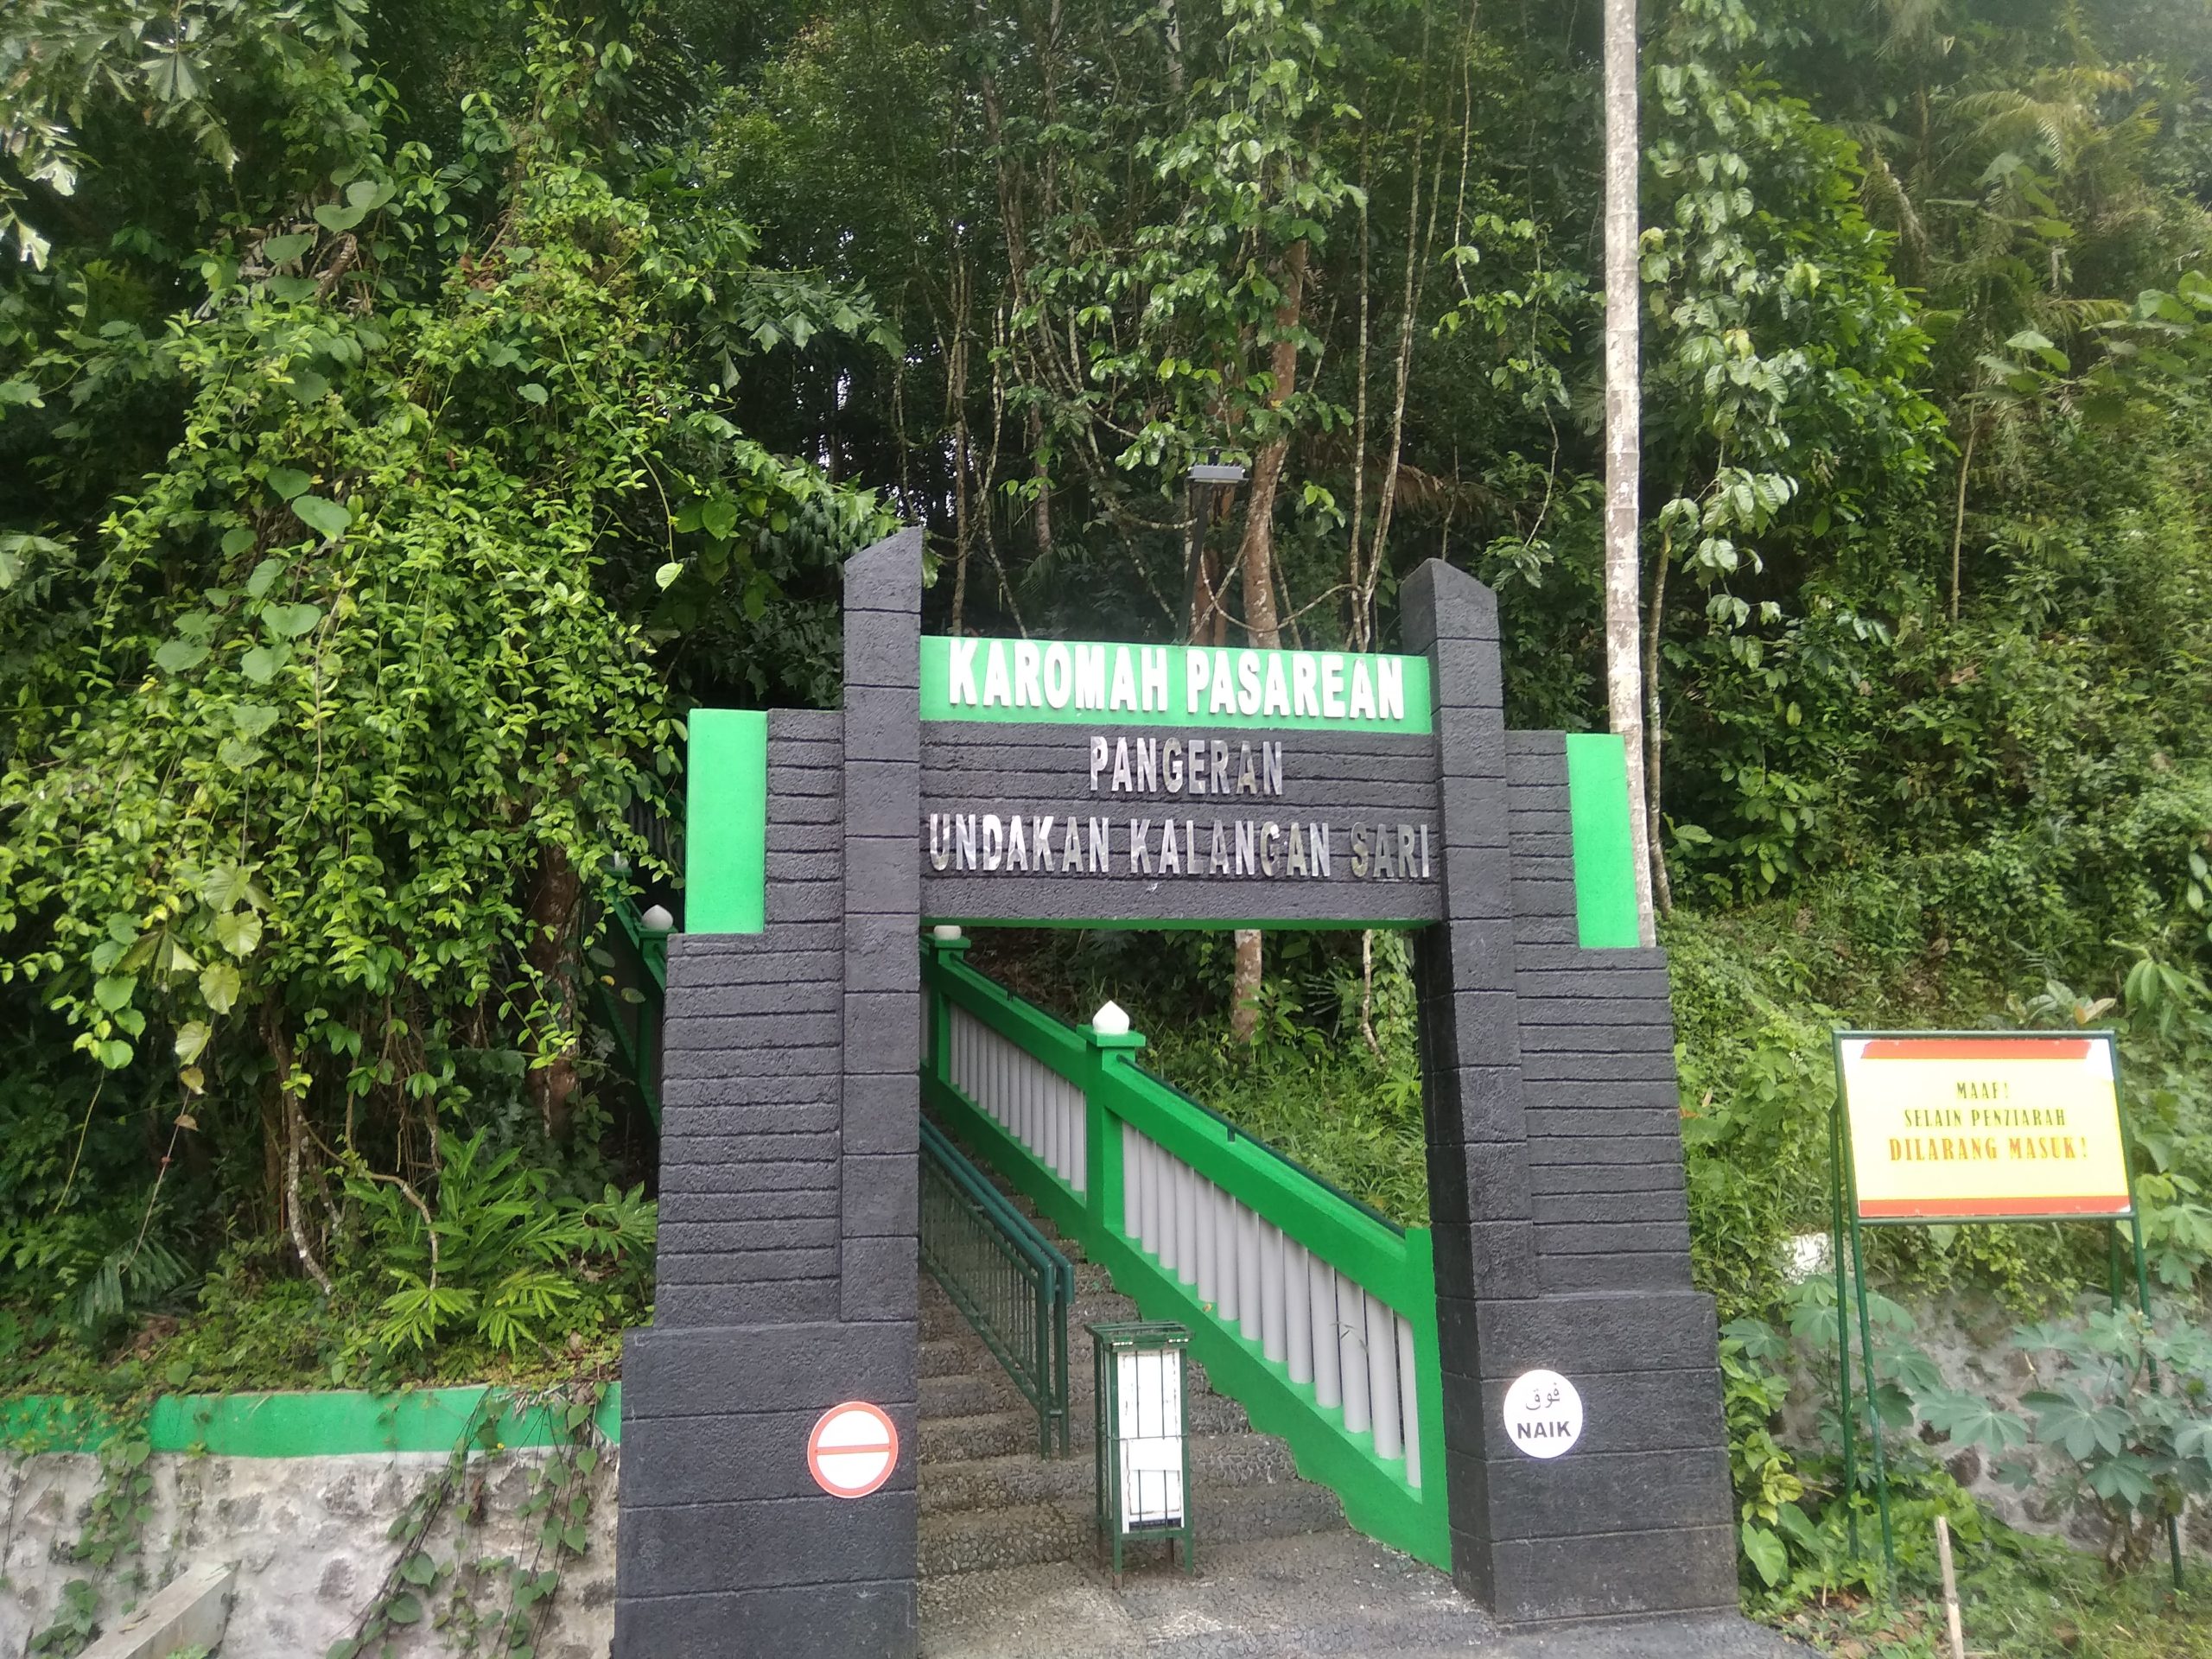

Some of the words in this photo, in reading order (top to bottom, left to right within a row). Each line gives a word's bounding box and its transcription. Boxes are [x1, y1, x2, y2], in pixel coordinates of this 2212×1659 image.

[949, 639, 1168, 712] KAROMAH
[1187, 650, 1405, 719] PASAREAN
[1090, 735, 1283, 796] PANGERAN
[930, 813, 1109, 873] UNDAKAN
[1130, 818, 1331, 877] KALANGAN
[1351, 822, 1430, 878] SARI
[1904, 1109, 1962, 1127] SELAIN
[1971, 1109, 2066, 1126] PENZIARAH
[1890, 1138, 1997, 1160] DILARANG
[1526, 1382, 1560, 1410] فوق
[1517, 1421, 1571, 1439] NAIK
